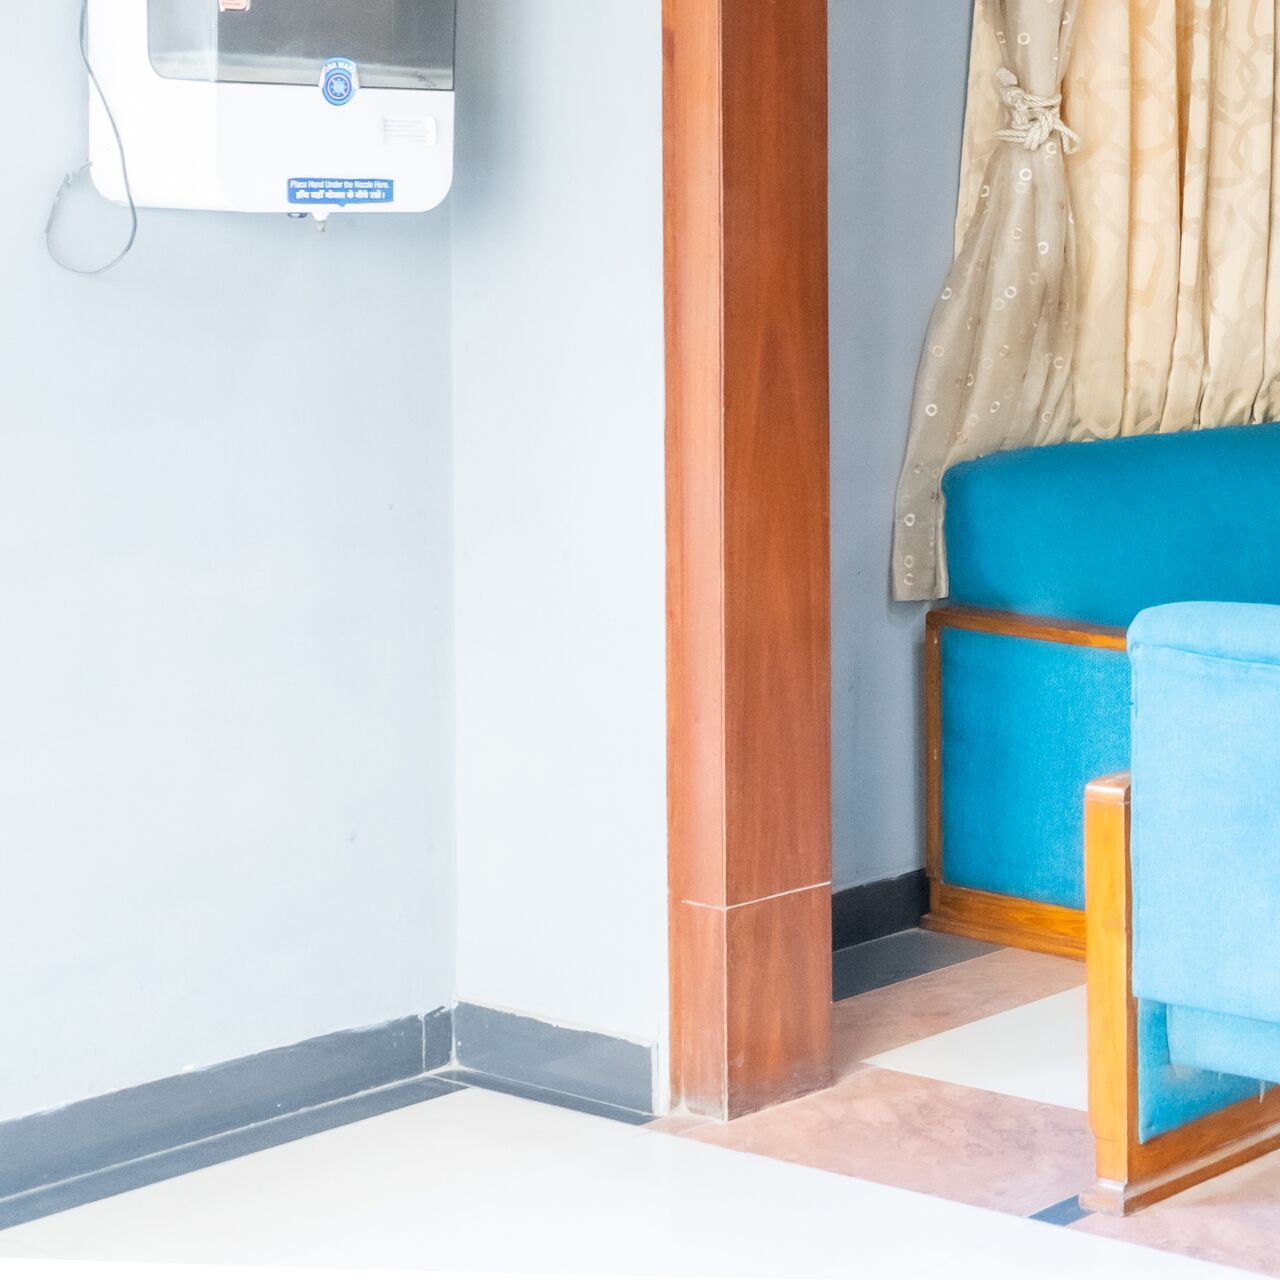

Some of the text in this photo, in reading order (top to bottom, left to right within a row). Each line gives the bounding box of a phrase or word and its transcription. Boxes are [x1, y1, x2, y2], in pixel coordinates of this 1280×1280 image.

[290, 181, 307, 189] Place
[308, 181, 324, 189] Hand
[325, 181, 343, 189] Under
[343, 181, 354, 189] the
[354, 181, 374, 189] Nozzle
